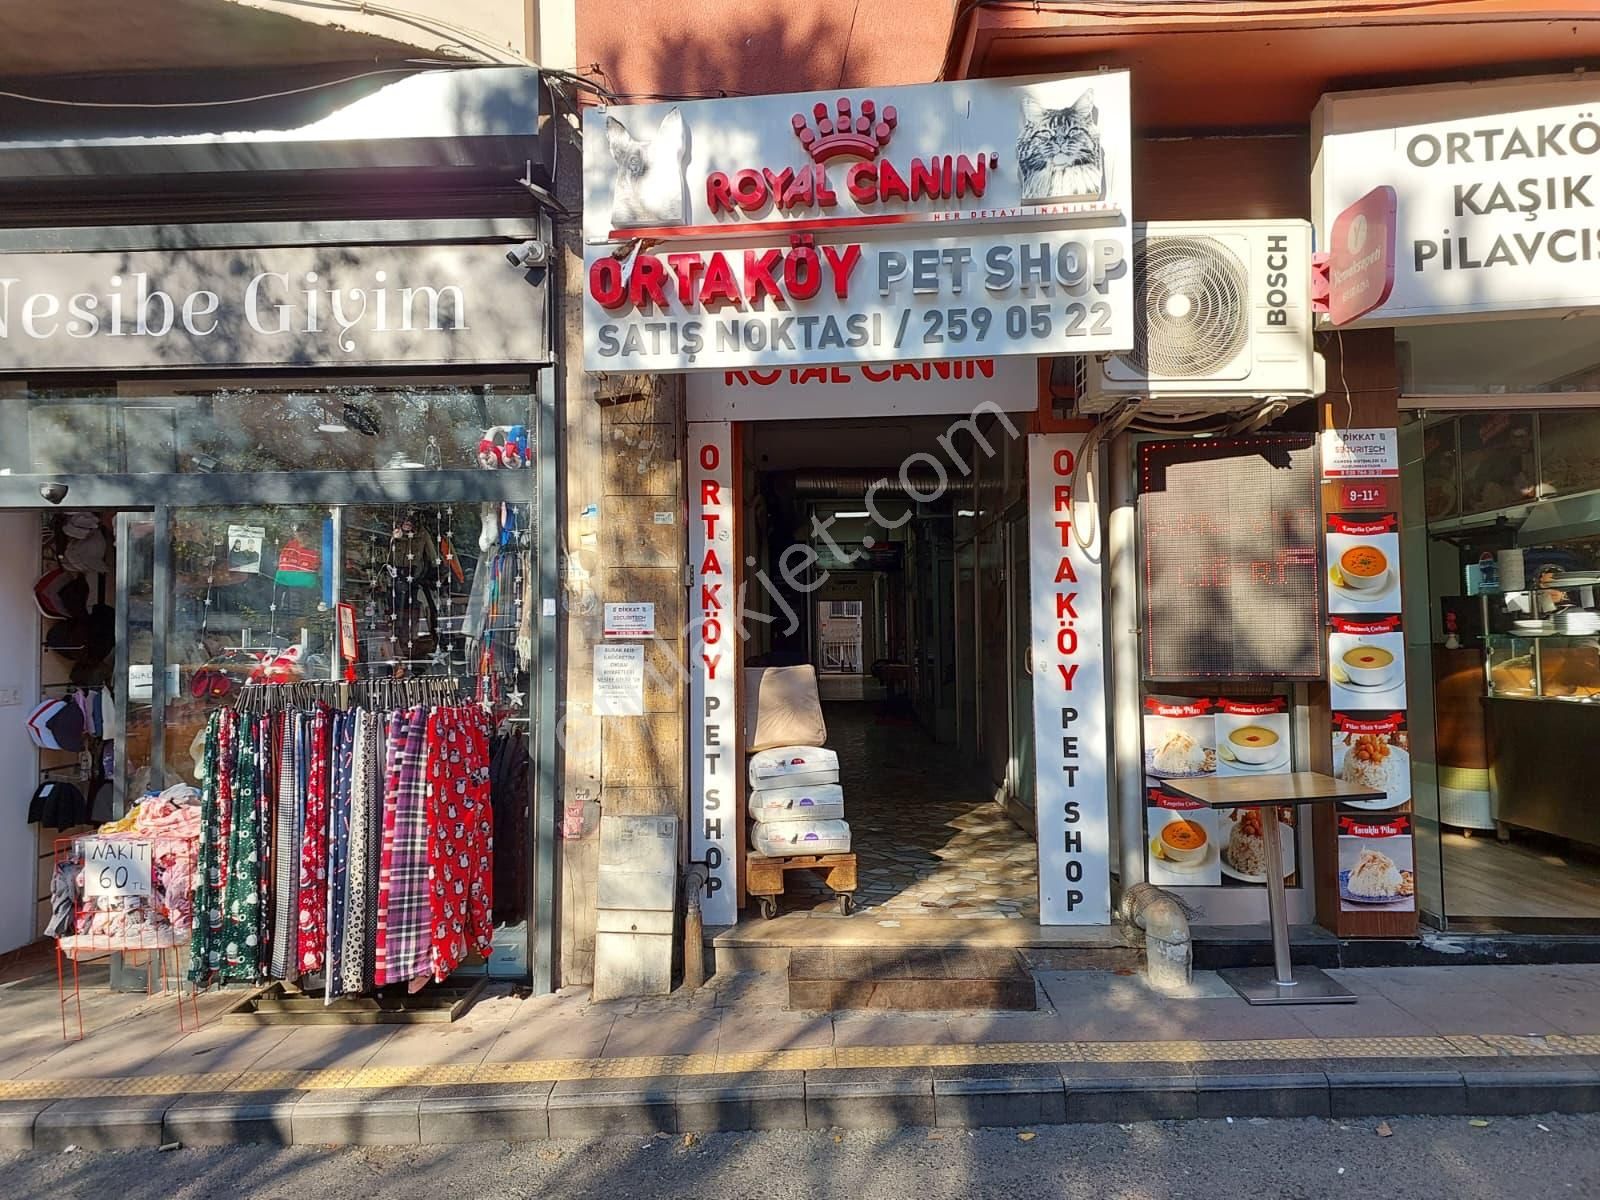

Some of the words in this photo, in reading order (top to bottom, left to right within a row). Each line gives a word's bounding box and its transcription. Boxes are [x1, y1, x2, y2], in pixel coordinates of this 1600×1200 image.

[706, 164, 836, 215] ROYAL
[934, 211, 961, 222] HER
[1453, 175, 1594, 221] KAŞIK
[589, 233, 861, 310] ORTAKÖY
[878, 246, 972, 296] PET
[985, 237, 1127, 292] SHOP
[1266, 234, 1288, 326] BOSCH
[1414, 229, 1600, 272] PİLAVCI
[244, 270, 470, 353] Giyim
[598, 319, 704, 362] SATIŞ
[717, 312, 883, 352] NOKTASI
[894, 309, 911, 349] /
[923, 306, 993, 345] 259
[1005, 303, 1052, 340] 05
[1064, 301, 1112, 337] 22
[1343, 432, 1376, 442] DİKKAT
[699, 444, 723, 681] ORTAKÖY
[1053, 449, 1080, 692] ORTAKÖY
[703, 696, 722, 776] PET
[1062, 707, 1079, 788] PET
[91, 842, 149, 861] NAKİT
[99, 866, 129, 888] 60
[132, 881, 147, 891] TL
[704, 787, 722, 899] SHOP
[1063, 801, 1083, 912] SHOP
